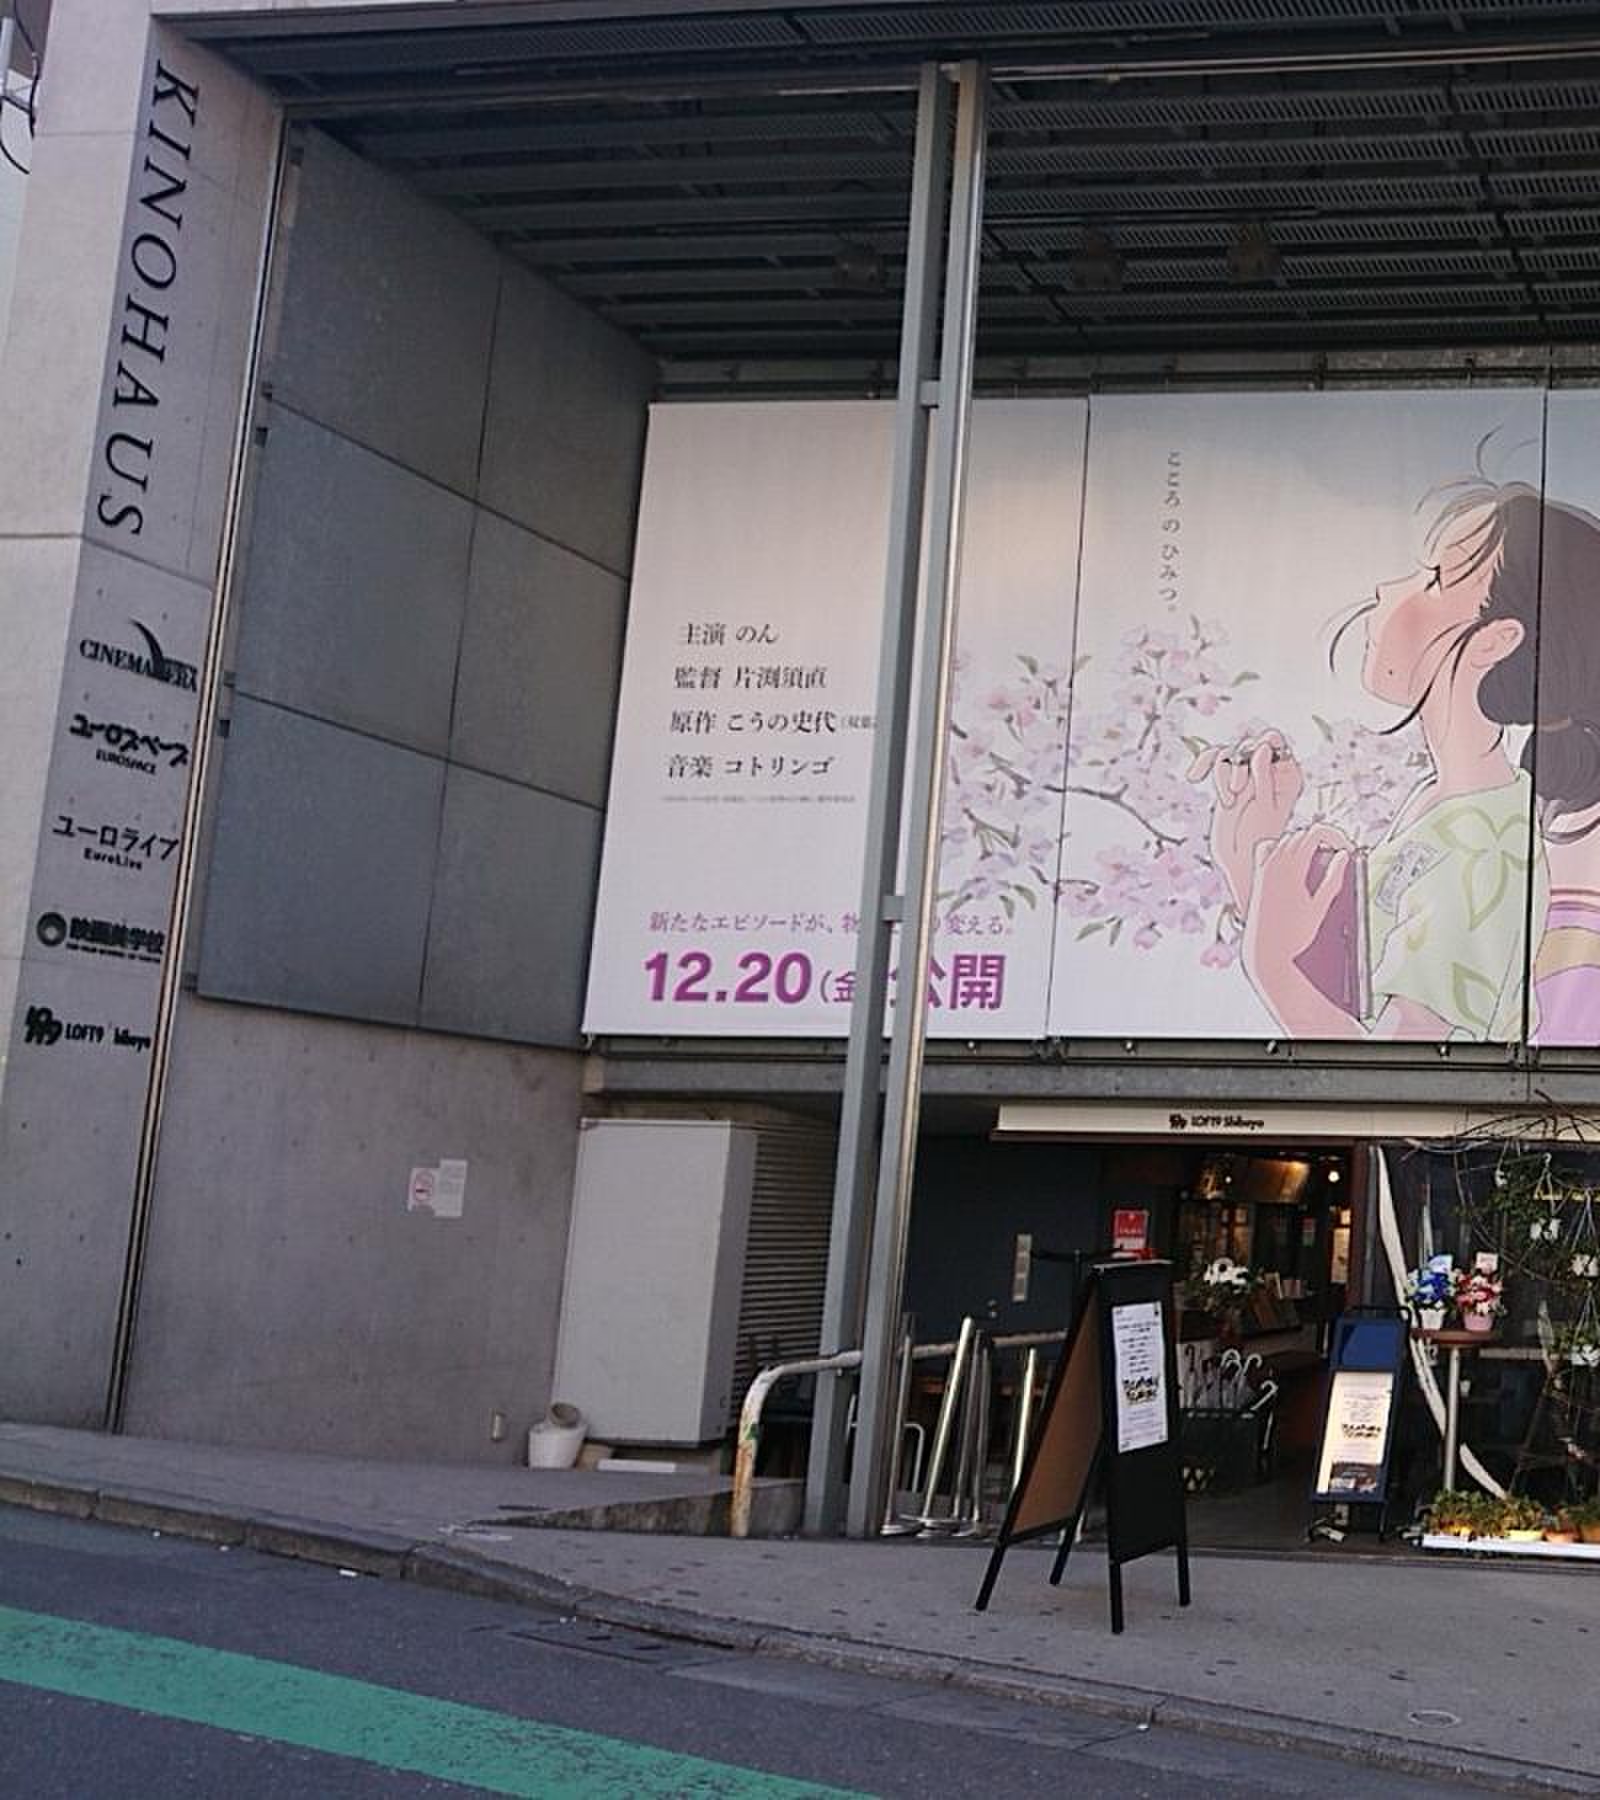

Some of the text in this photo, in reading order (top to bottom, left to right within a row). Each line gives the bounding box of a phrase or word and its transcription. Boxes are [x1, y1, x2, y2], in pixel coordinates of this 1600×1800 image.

[97, 59, 200, 536] KINOHAUS
[681, 622, 780, 646] 主演 のん
[674, 665, 722, 690] 監督
[670, 710, 716, 734] 原作
[727, 710, 837, 734] こうの史代
[666, 754, 835, 779] 音楽 コトリンゴ
